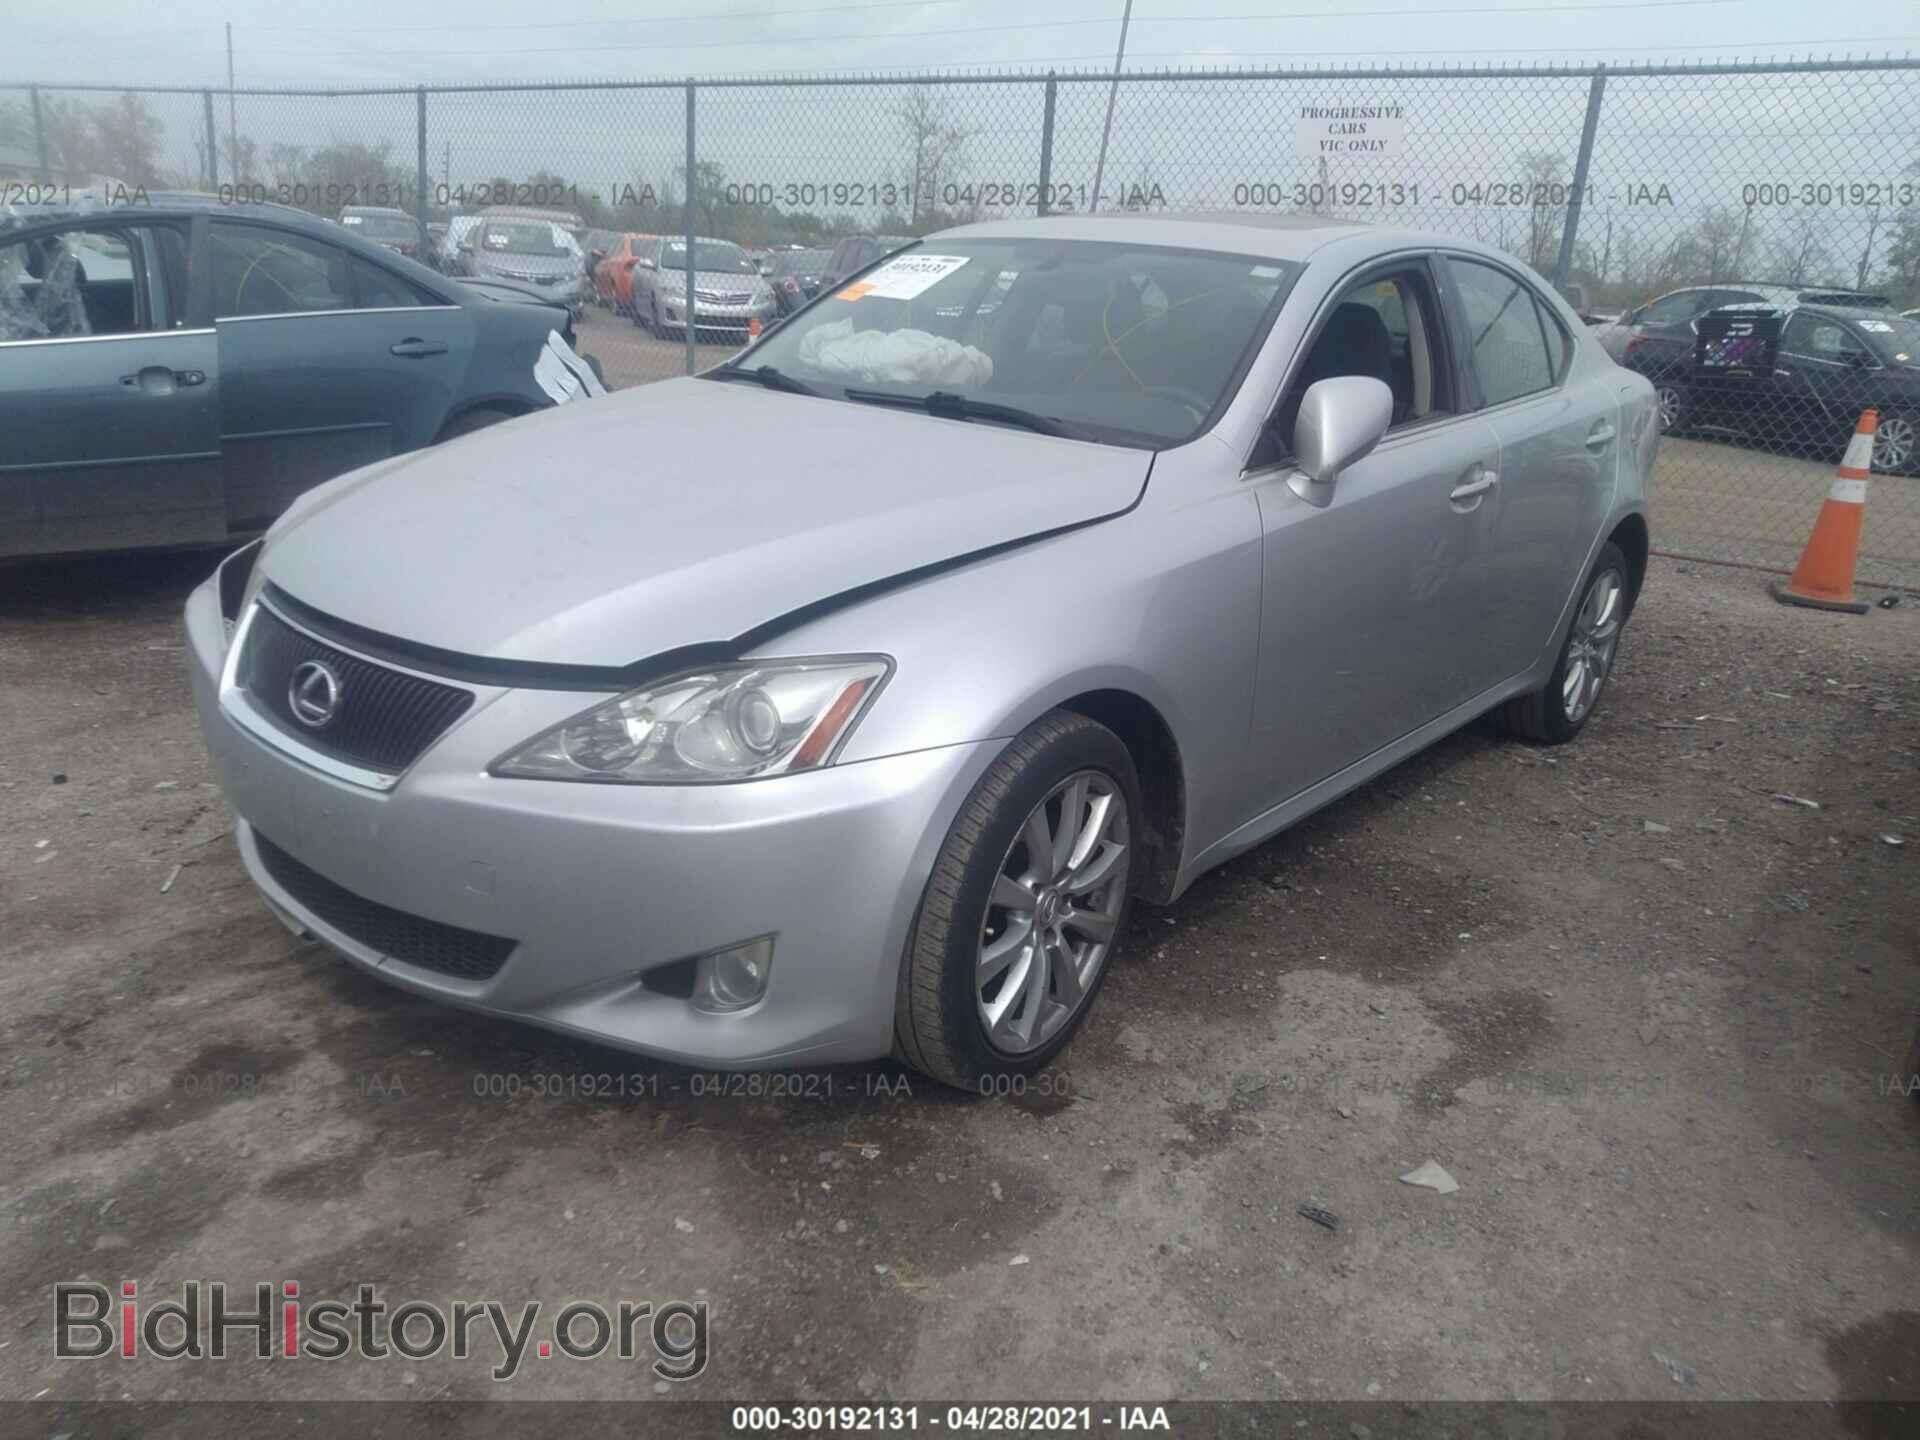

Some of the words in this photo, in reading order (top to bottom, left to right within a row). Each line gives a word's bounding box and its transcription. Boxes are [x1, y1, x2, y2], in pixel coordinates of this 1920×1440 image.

[1300, 106, 1404, 119] PROGRESSIVE
[1328, 122, 1367, 135] CARS
[1319, 139, 1344, 152] VIC
[1348, 139, 1388, 152] ONLY
